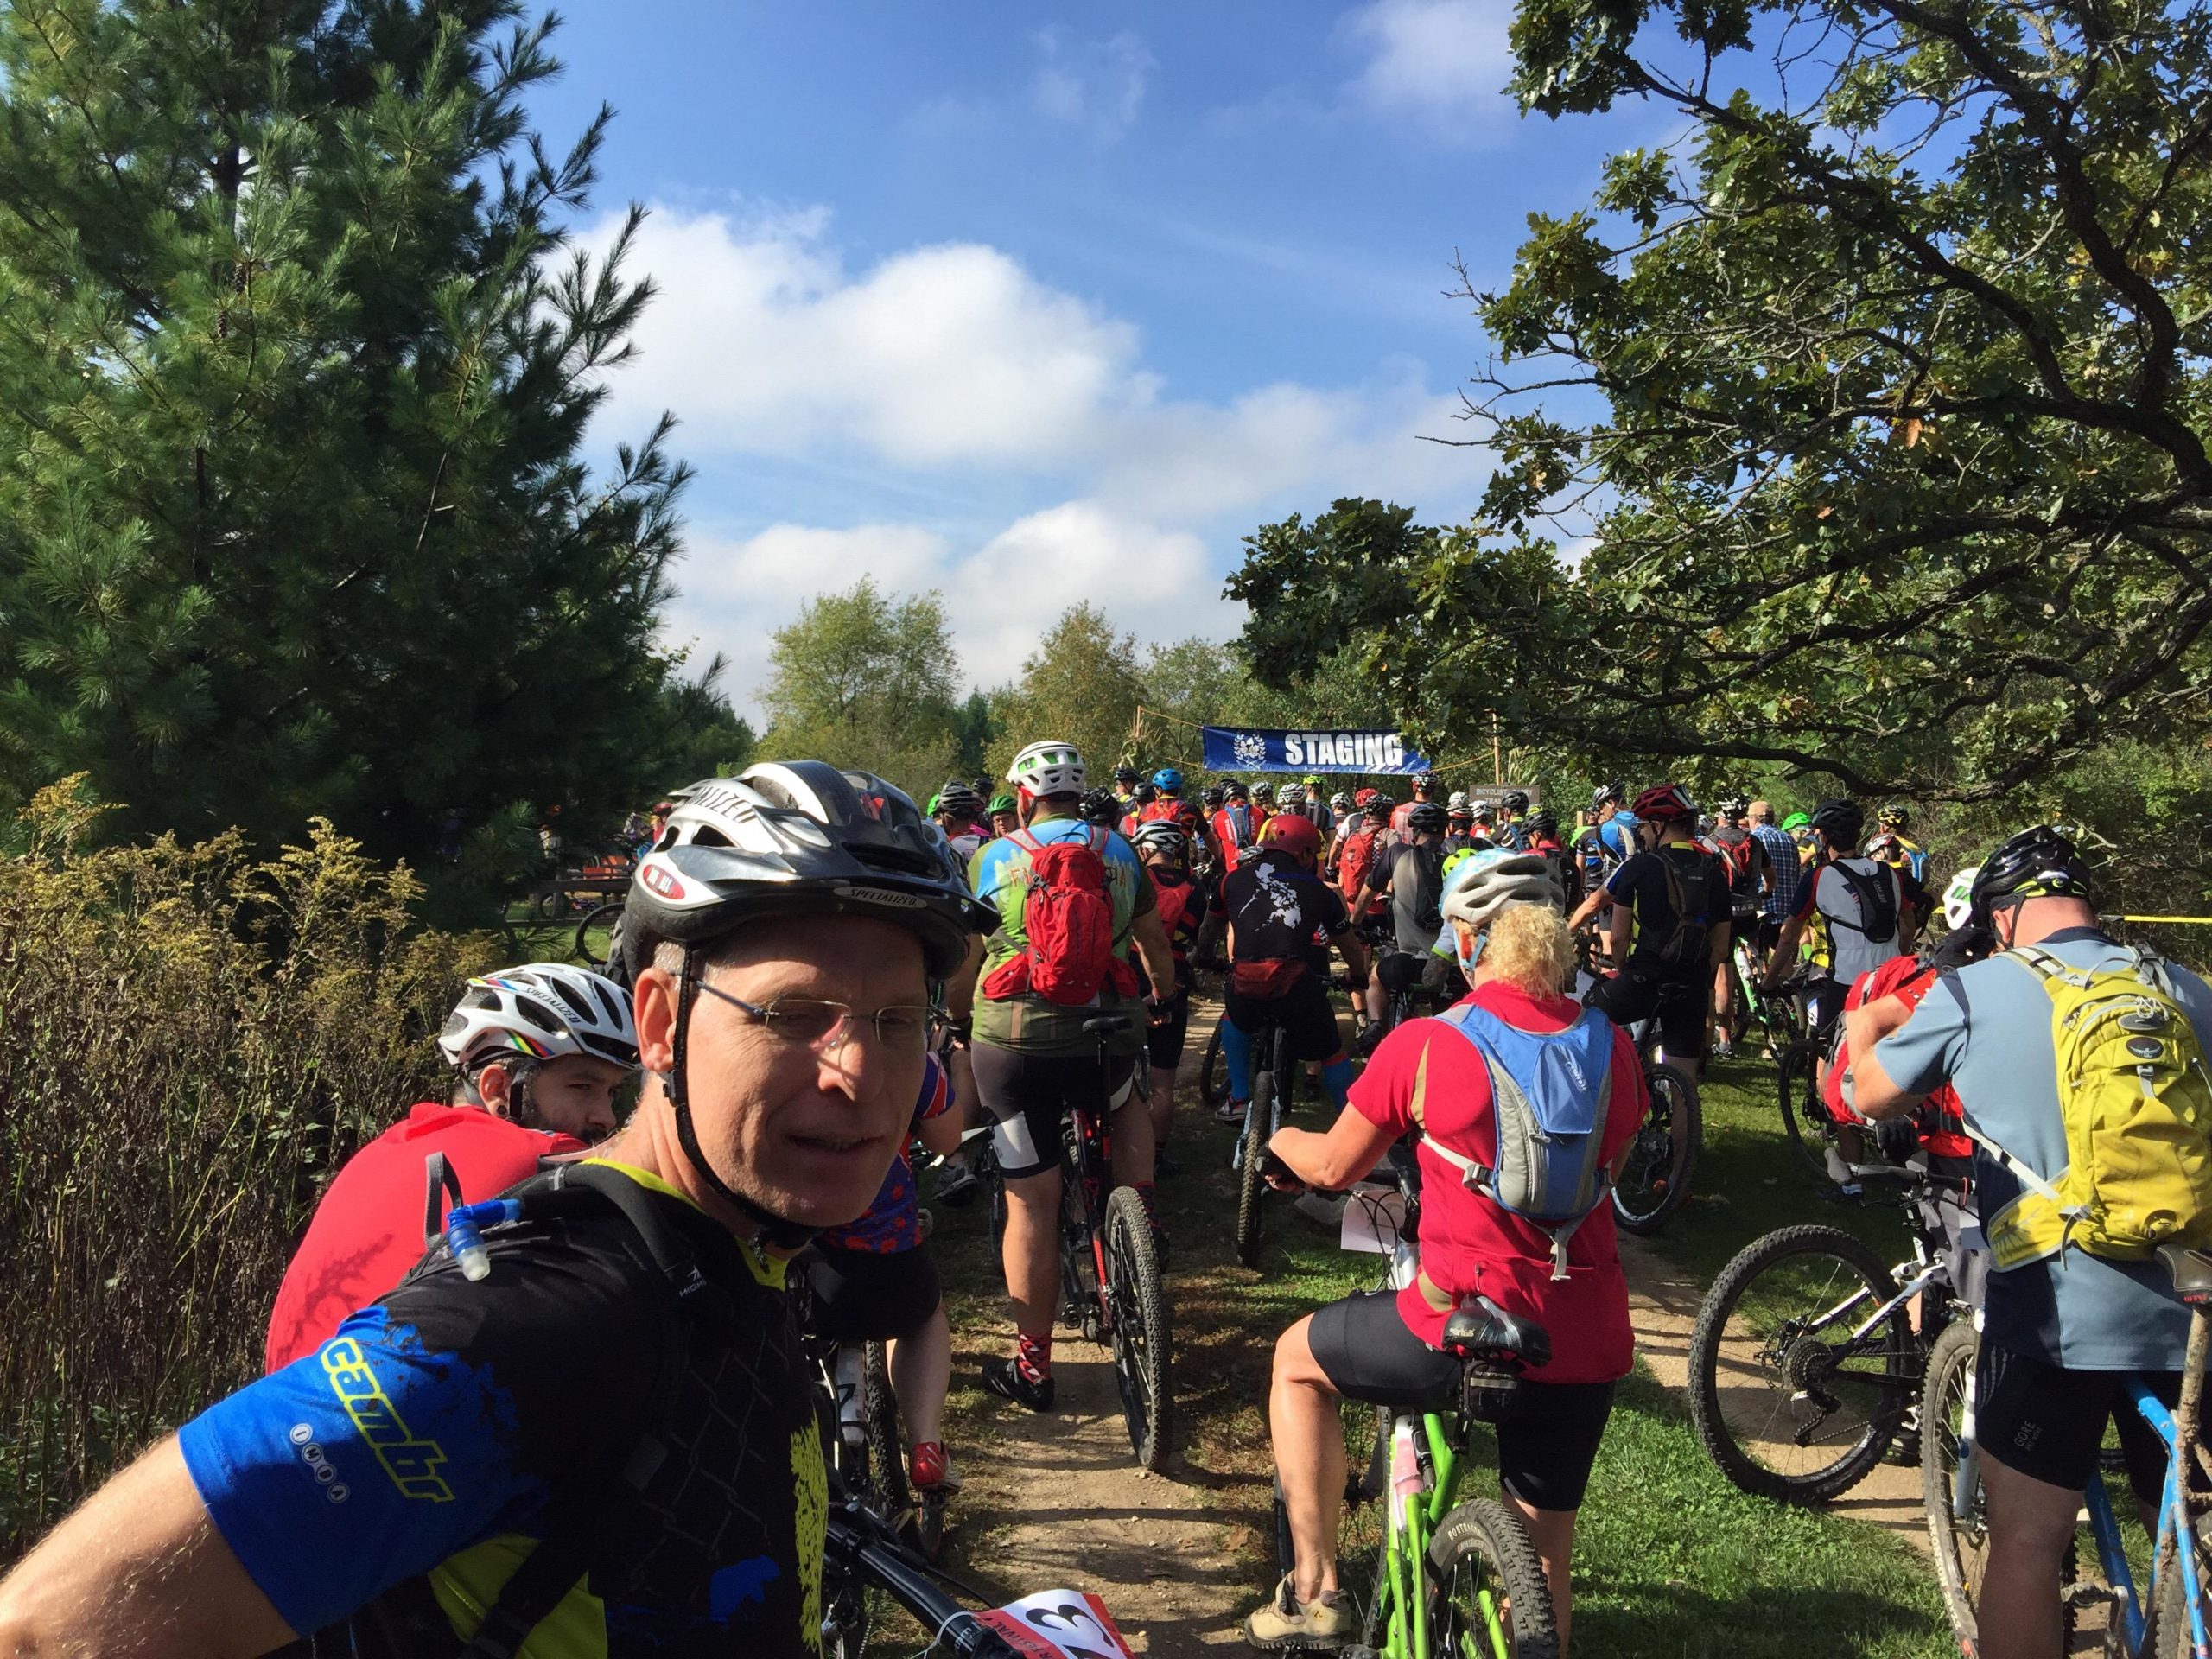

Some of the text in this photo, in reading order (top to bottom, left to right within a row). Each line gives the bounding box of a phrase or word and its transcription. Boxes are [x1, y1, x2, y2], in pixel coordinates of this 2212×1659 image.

[1284, 733, 1403, 766] STAGING
[850, 887, 917, 906] SPECIALIZED
[525, 987, 582, 1024] SPECIALIZED
[2013, 1419, 2037, 1448] GORE
